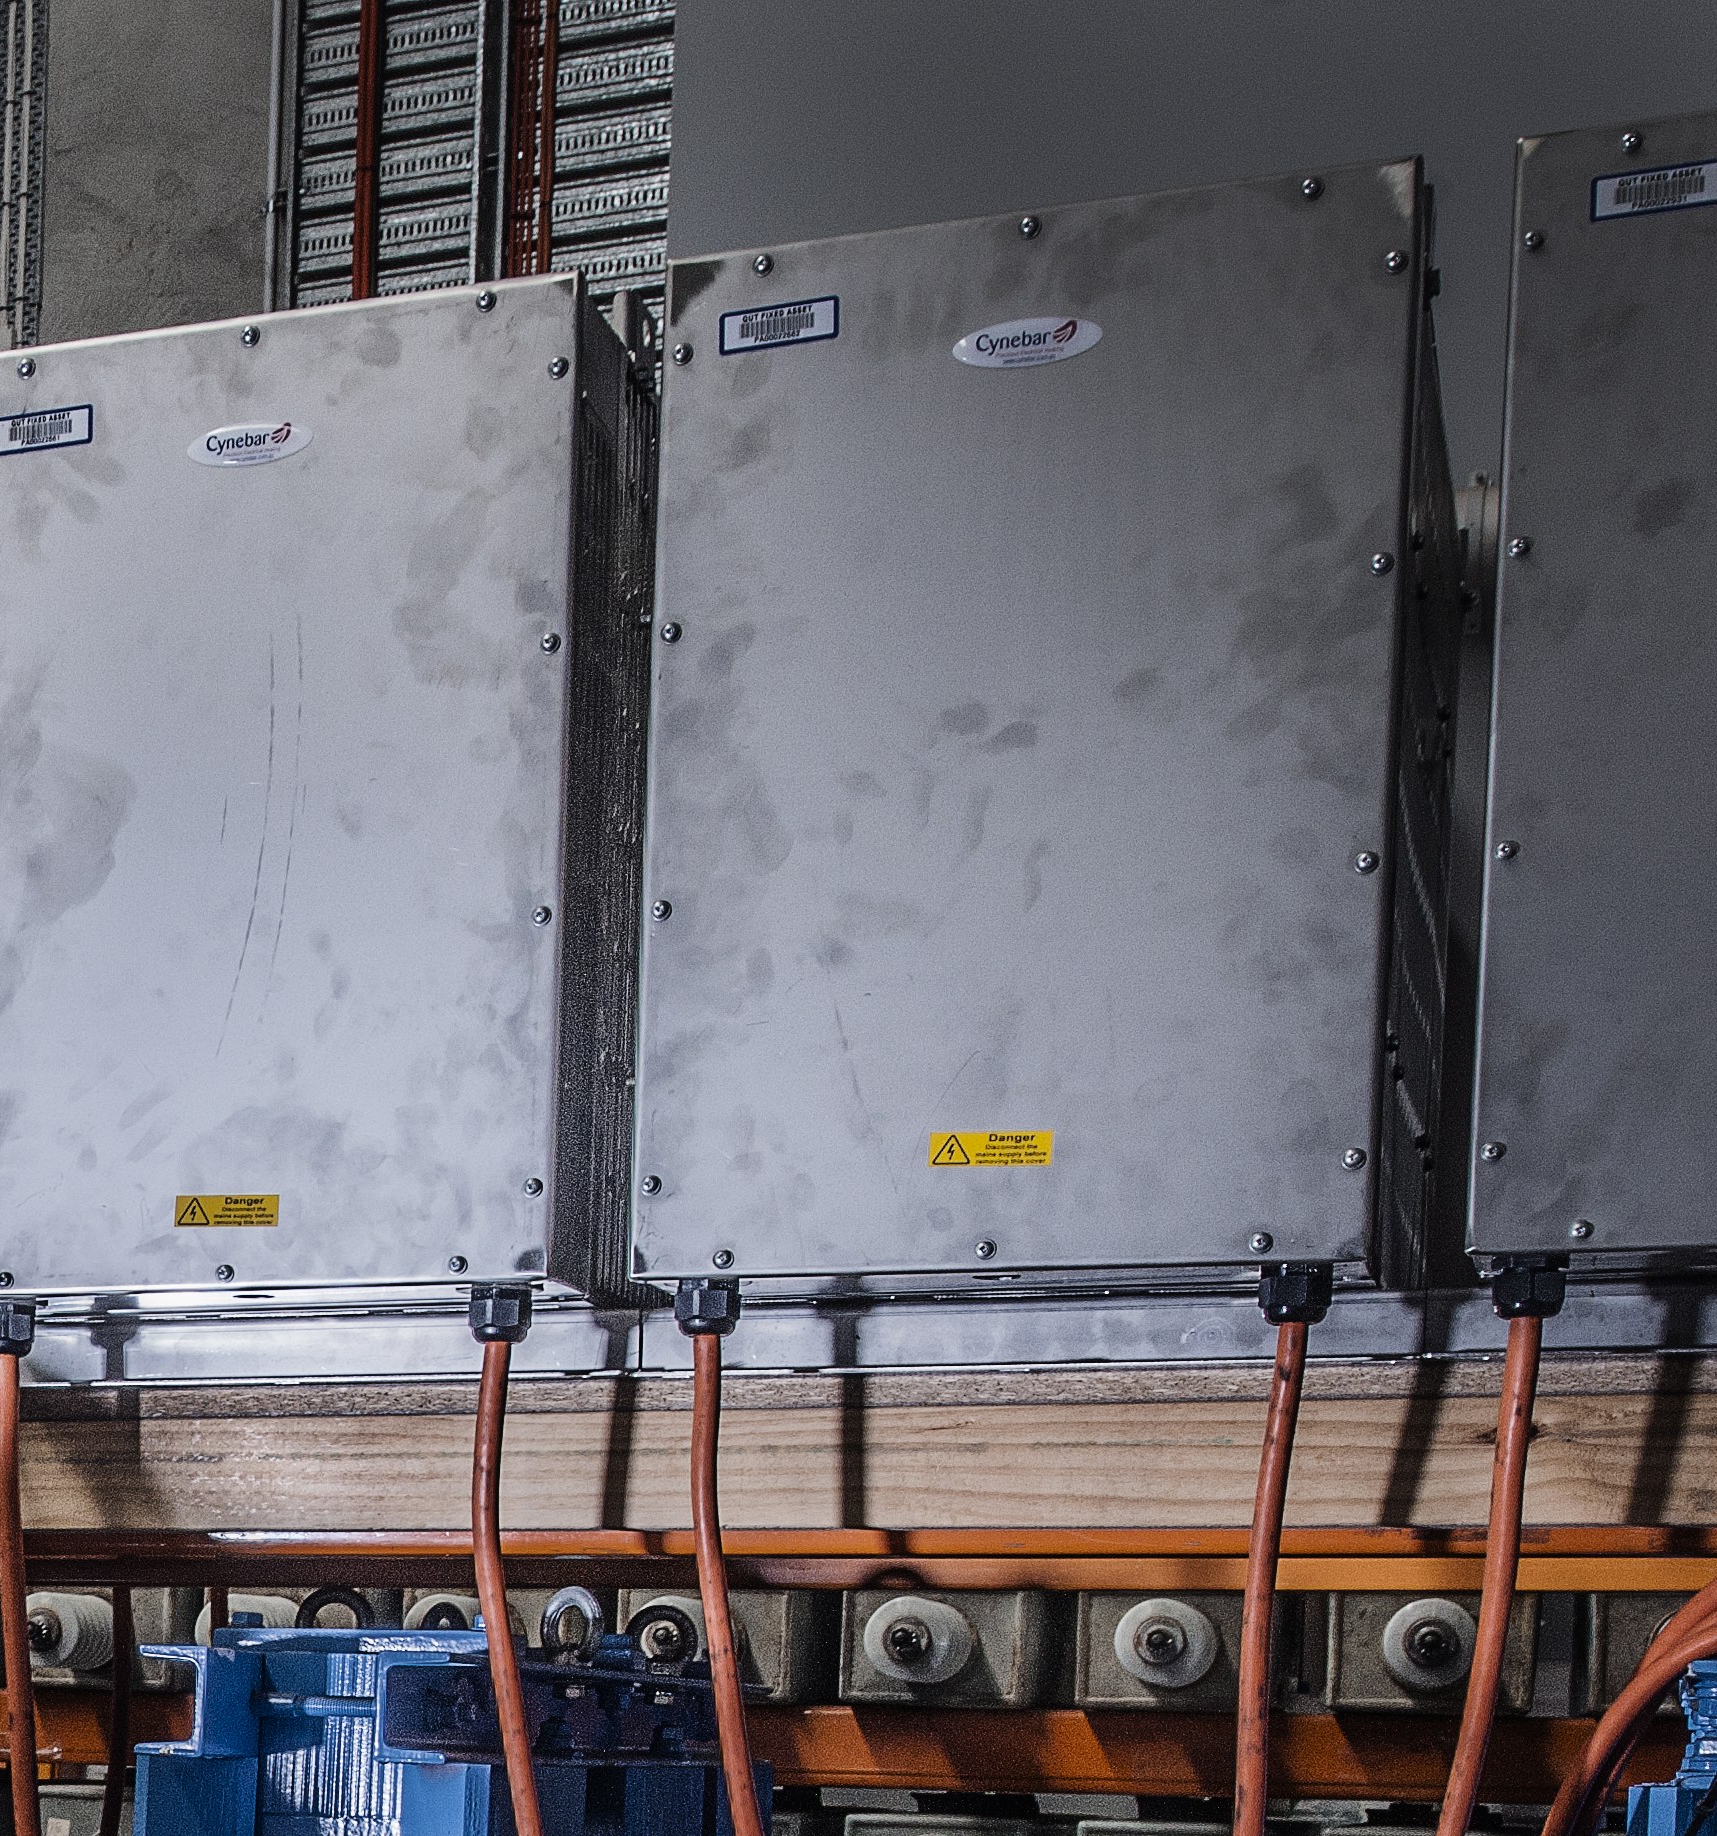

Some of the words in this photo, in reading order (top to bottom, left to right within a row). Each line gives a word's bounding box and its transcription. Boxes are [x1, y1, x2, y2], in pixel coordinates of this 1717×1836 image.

[1618, 177, 1638, 187] QUT
[976, 330, 1053, 356] Cynebar
[206, 433, 270, 455] Cynebar
[988, 1133, 1036, 1143] Danger
[225, 1197, 264, 1206] Danger
